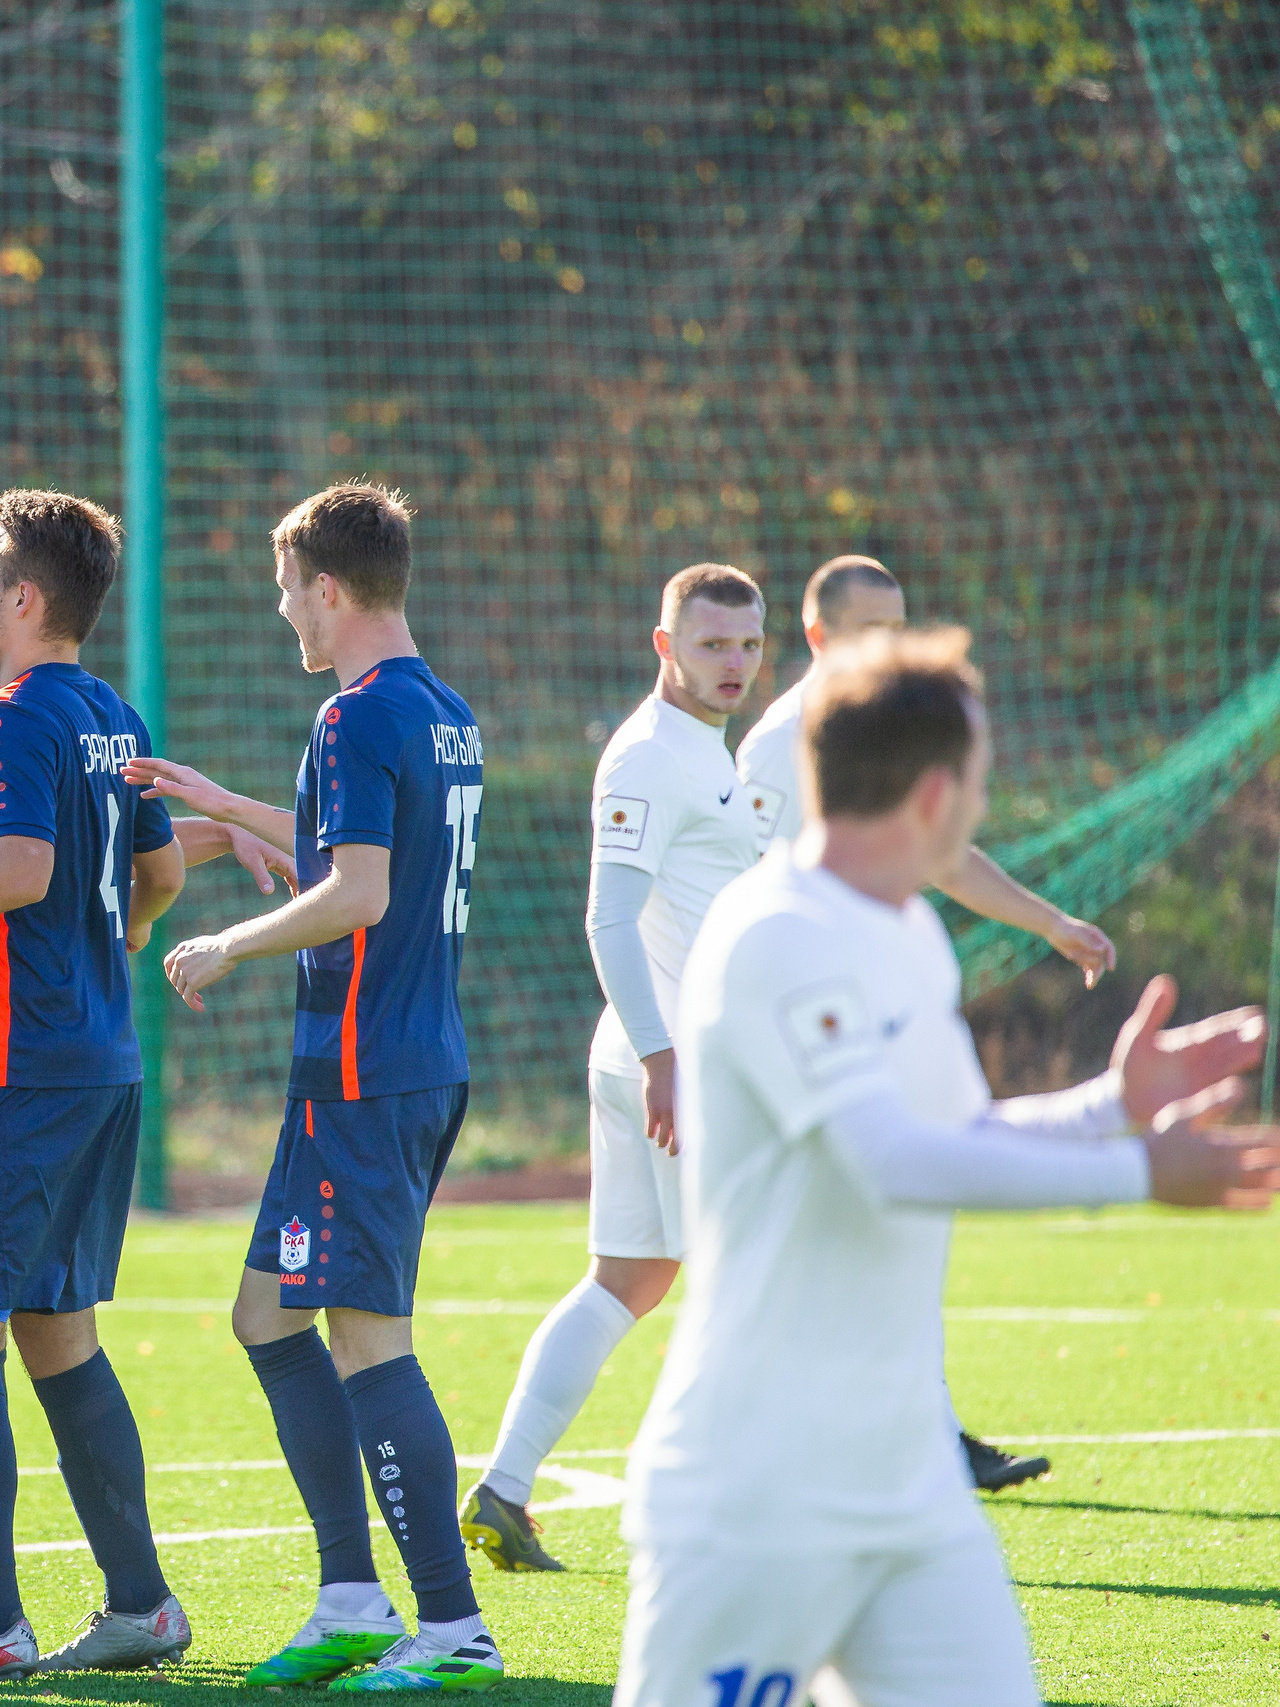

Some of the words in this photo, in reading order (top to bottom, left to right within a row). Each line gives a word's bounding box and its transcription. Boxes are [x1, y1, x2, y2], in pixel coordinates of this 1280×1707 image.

[443, 785, 483, 934] 15
[280, 1274, 306, 1286] JAKO
[378, 1440, 396, 1459] 15
